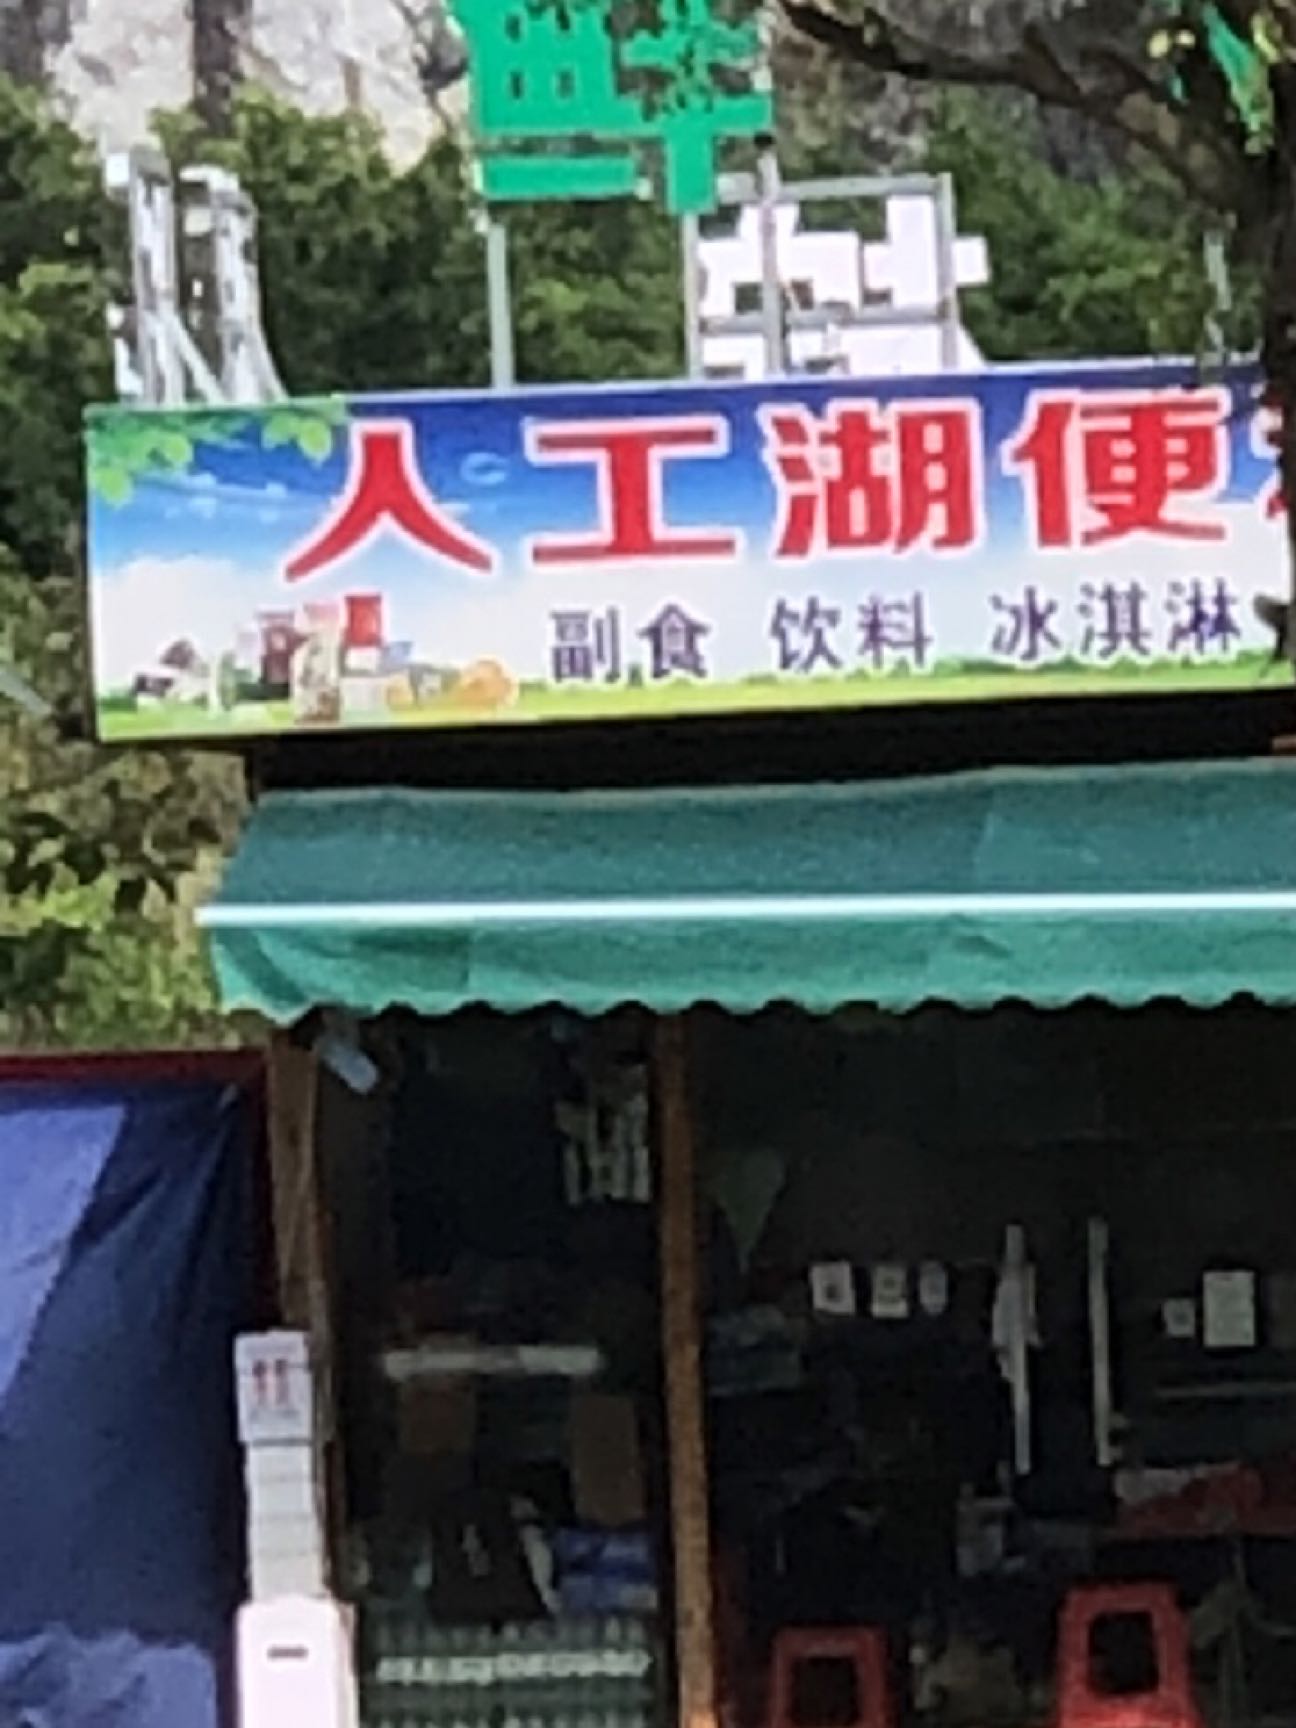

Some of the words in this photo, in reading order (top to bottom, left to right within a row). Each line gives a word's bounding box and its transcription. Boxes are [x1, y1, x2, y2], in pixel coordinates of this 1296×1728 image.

[549, 604, 712, 681] 副食
[770, 594, 934, 673] 饮料
[989, 577, 1242, 663] 冰淇淋
